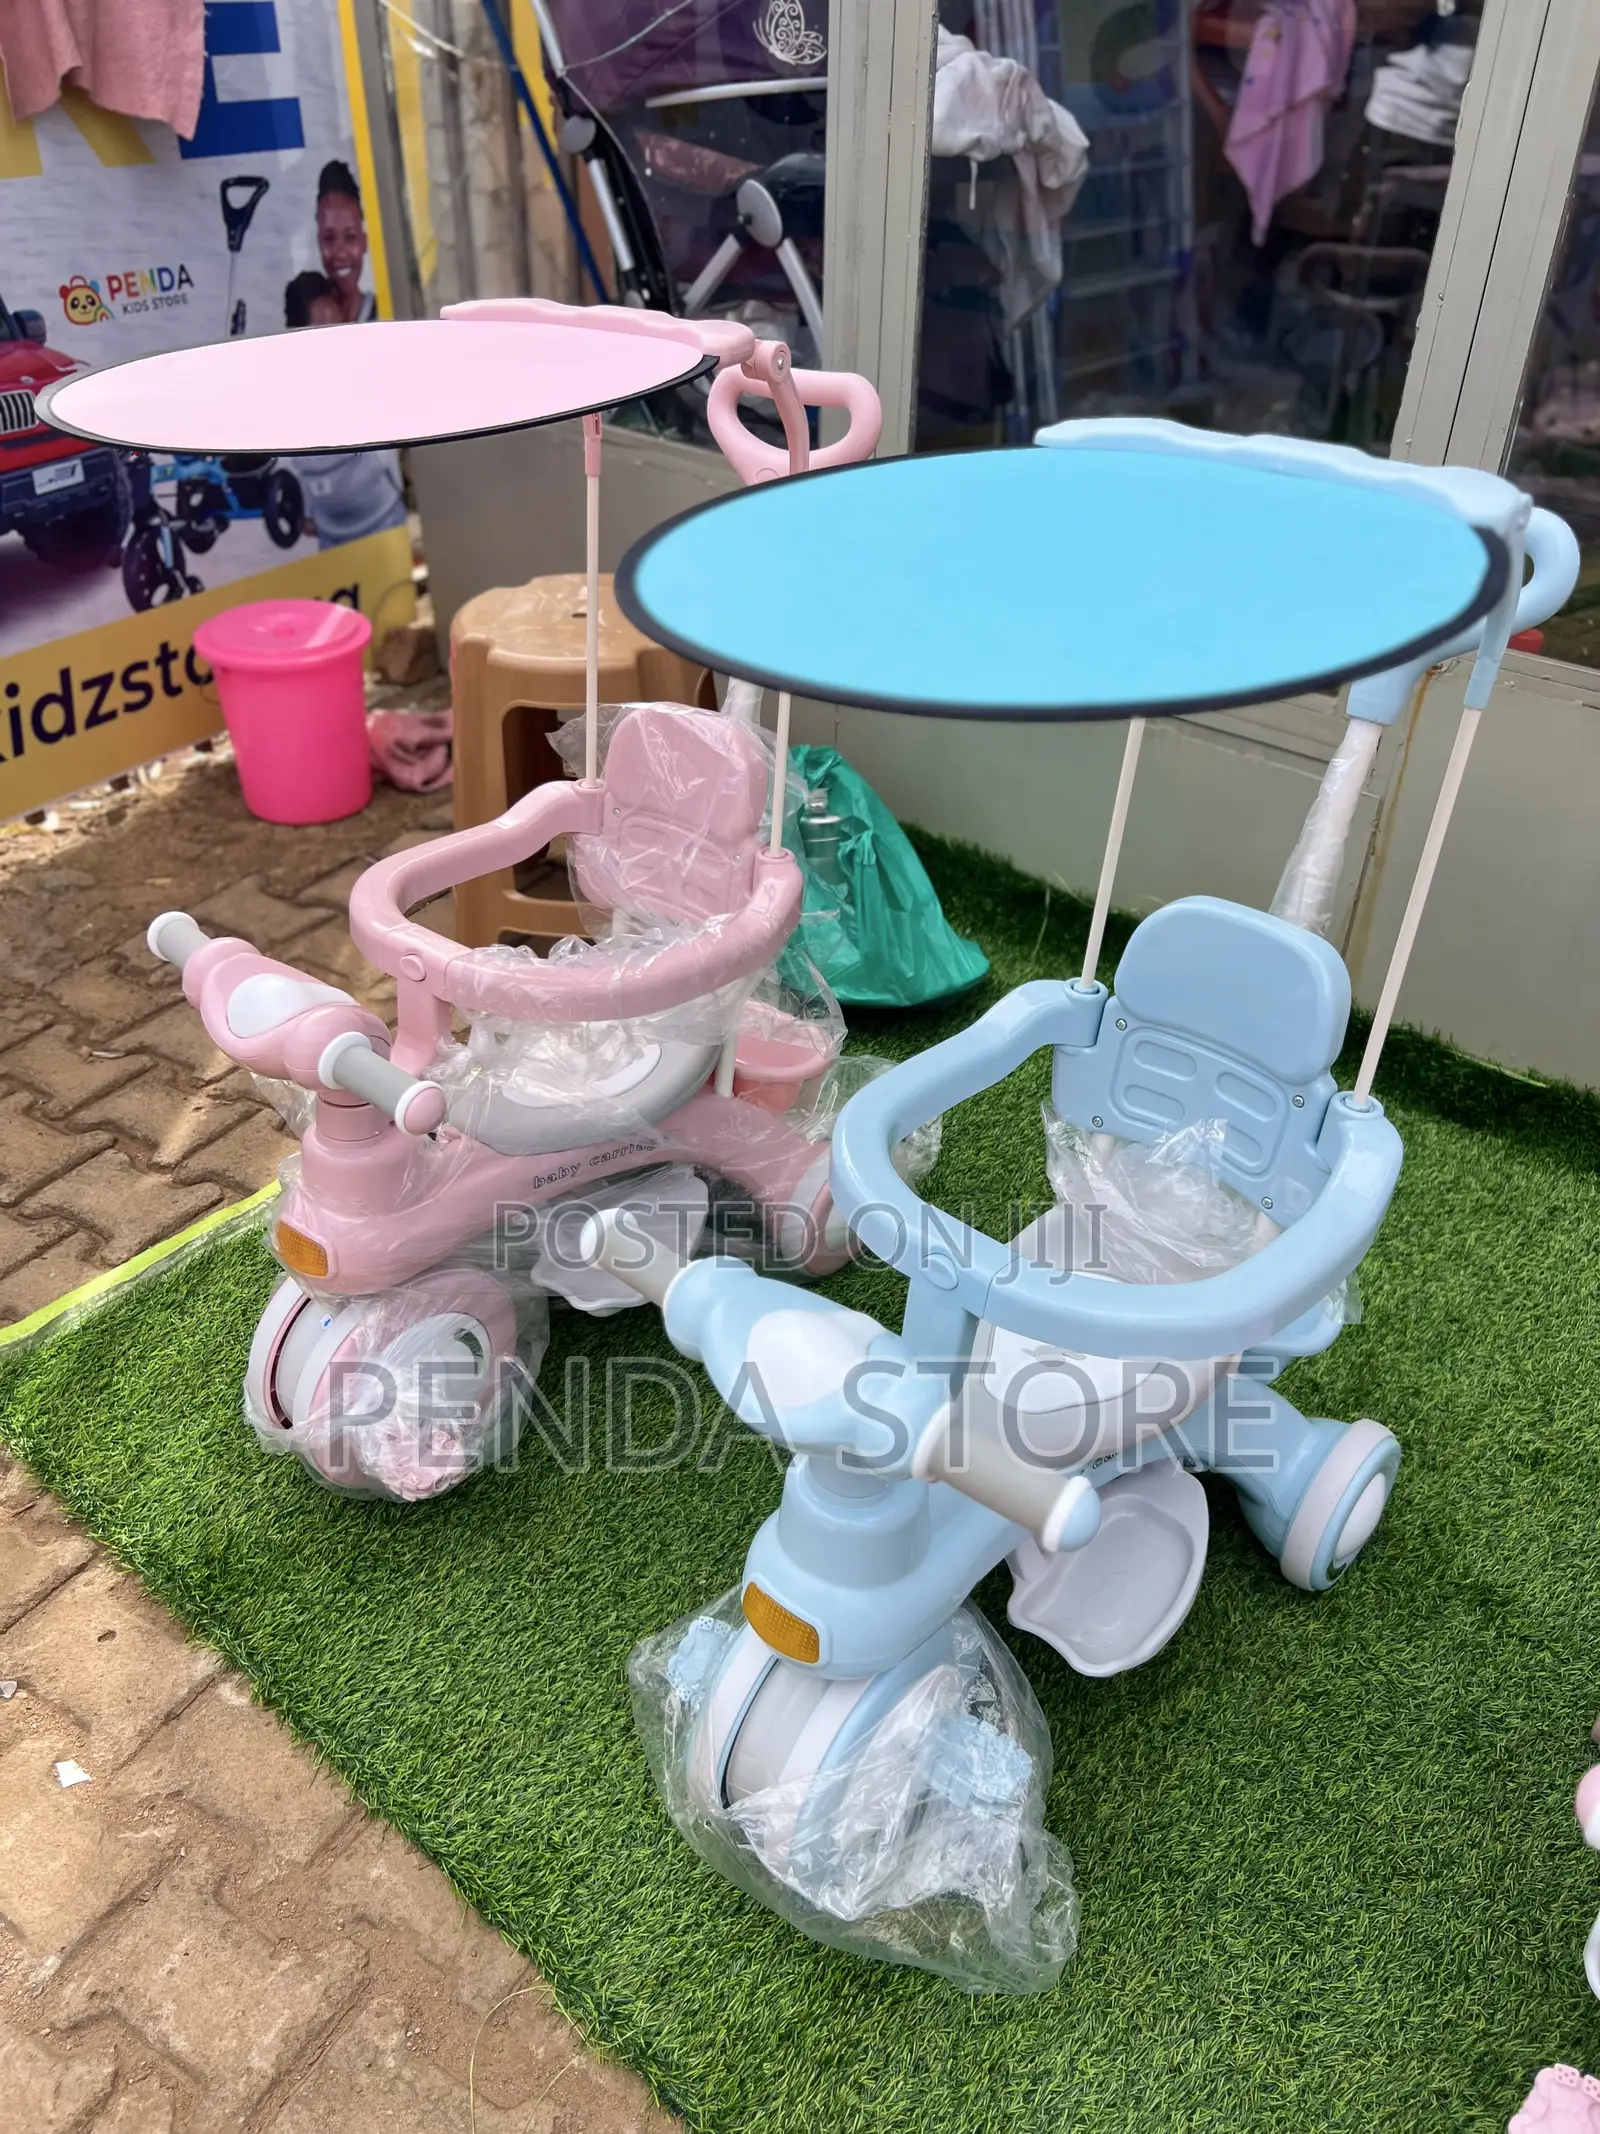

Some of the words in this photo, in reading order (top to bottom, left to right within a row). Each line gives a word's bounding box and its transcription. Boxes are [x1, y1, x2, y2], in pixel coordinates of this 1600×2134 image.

[106, 263, 195, 302] PENDA
[121, 298, 150, 315] KIDS
[151, 293, 188, 311] STORE
[0, 640, 214, 764] idzsto
[533, 1161, 582, 1190] baby
